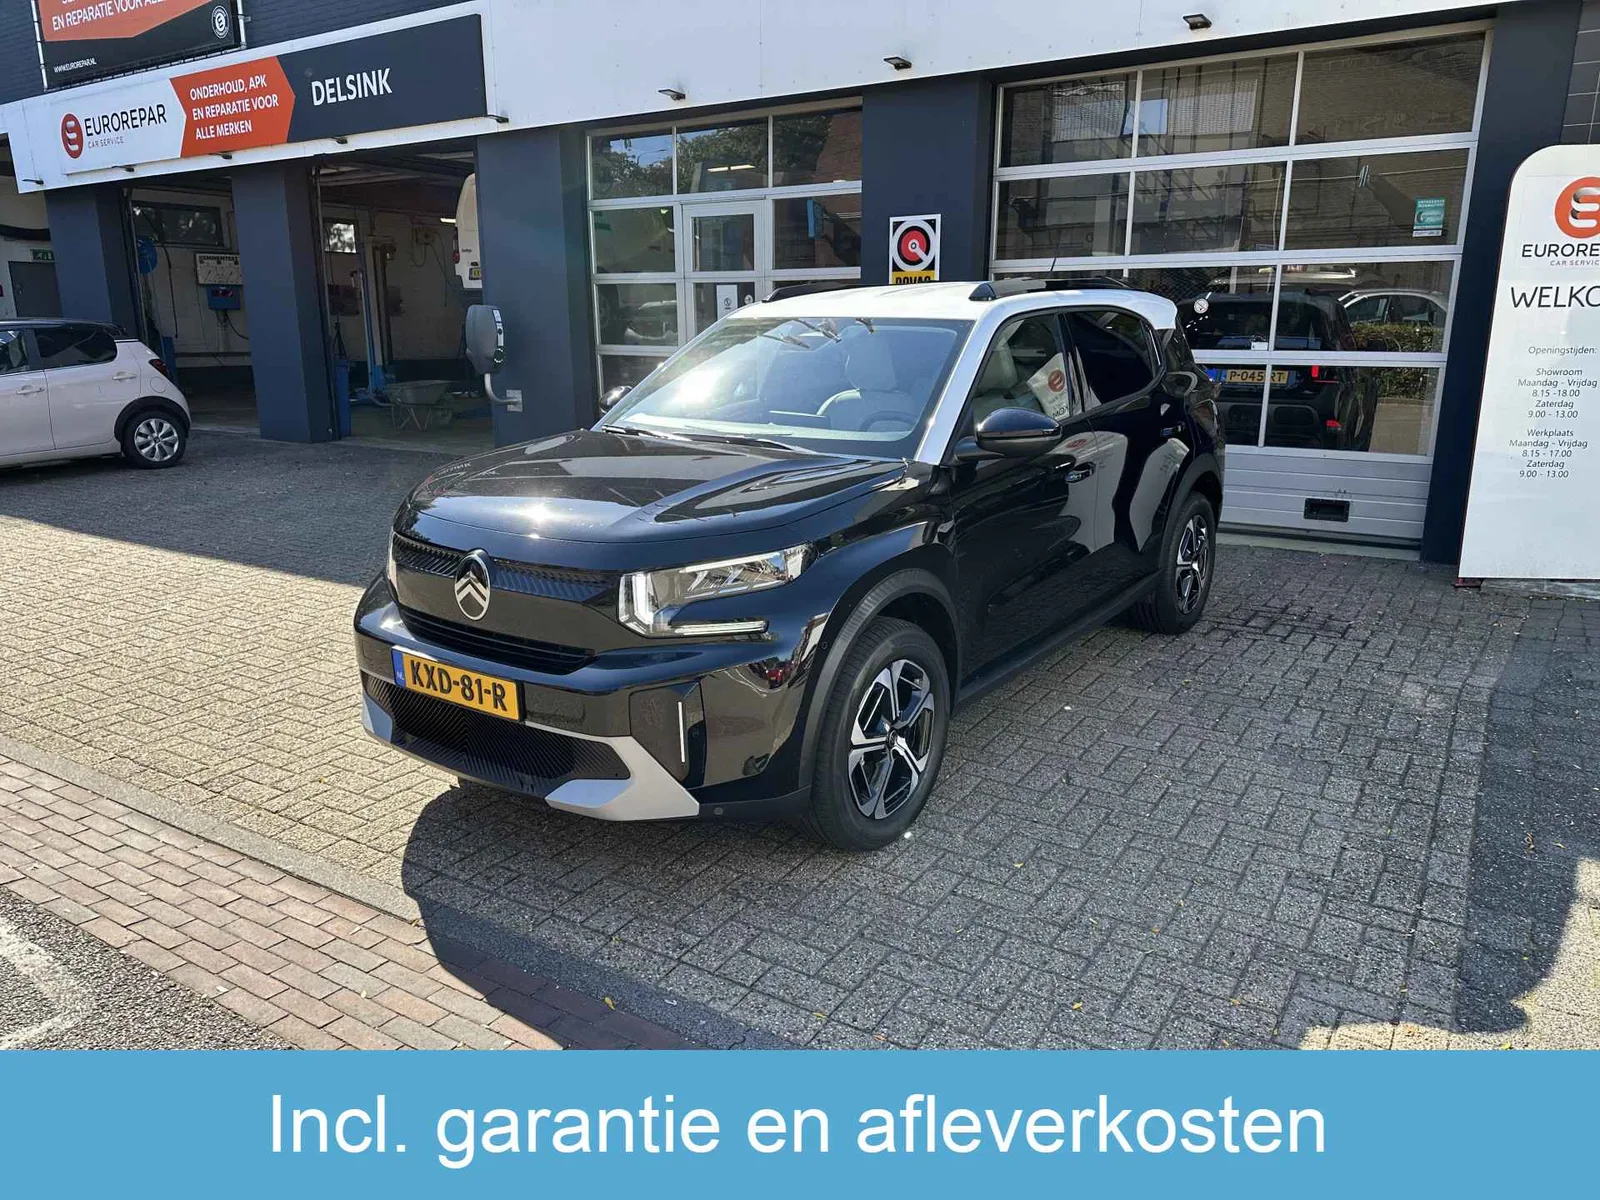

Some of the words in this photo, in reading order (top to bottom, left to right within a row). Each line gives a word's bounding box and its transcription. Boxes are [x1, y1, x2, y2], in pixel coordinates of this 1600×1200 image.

[52, 15, 65, 31] EN
[66, 2, 114, 27] REPARATIE
[190, 78, 248, 100] ONDERHOUD,
[249, 74, 267, 90] APK
[311, 67, 393, 107] DELSINK
[192, 106, 204, 121] EN
[205, 98, 251, 119] REPARATIE
[251, 93, 280, 111] VOOR
[84, 103, 168, 137] EUROREPAR
[195, 123, 216, 141] ALLE
[216, 120, 253, 137] MERKEN
[87, 139, 100, 149] CAR
[100, 136, 125, 148] SERVICE
[1535, 367, 1583, 376] Showroom
[1517, 379, 1559, 389] Maandag
[1567, 379, 1599, 389] Vrijdag
[1531, 389, 1551, 398] 8.15
[1534, 400, 1575, 410] Zaterdag
[1527, 410, 1547, 419] 9.00
[1556, 410, 1579, 419] 13.00
[1526, 428, 1575, 439] Werkplaats
[1508, 440, 1550, 450] Maandag
[1558, 439, 1589, 450] Vrijdag
[1521, 449, 1540, 458] 8.15
[1549, 449, 1573, 458] 17.00
[1526, 459, 1566, 470] Zaterdag
[1519, 470, 1538, 479] 9.00
[1547, 470, 1570, 479] 13.00
[410, 659, 508, 712] KXD-81-R
